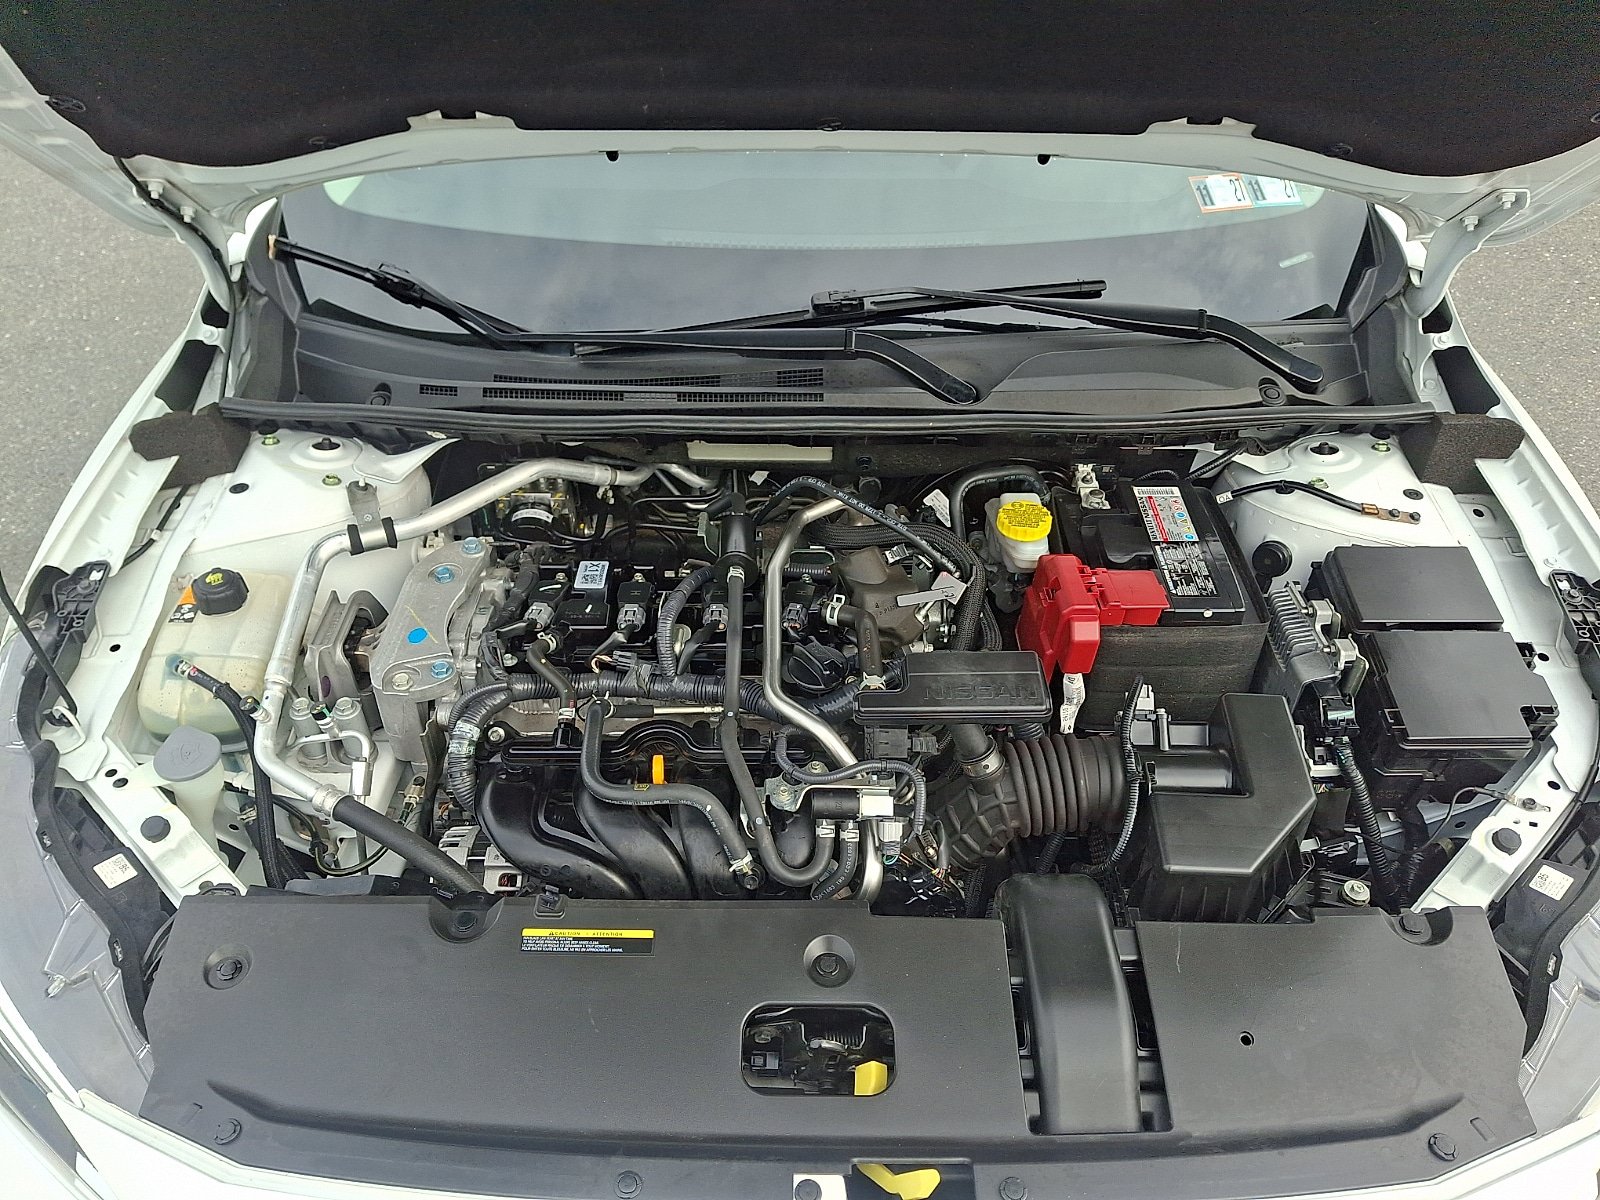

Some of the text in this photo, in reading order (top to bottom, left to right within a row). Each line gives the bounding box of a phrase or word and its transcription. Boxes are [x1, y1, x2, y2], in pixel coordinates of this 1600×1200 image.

[1196, 178, 1246, 206] 11 27
[1248, 179, 1267, 201] 11
[924, 682, 1039, 700] NISSAN
